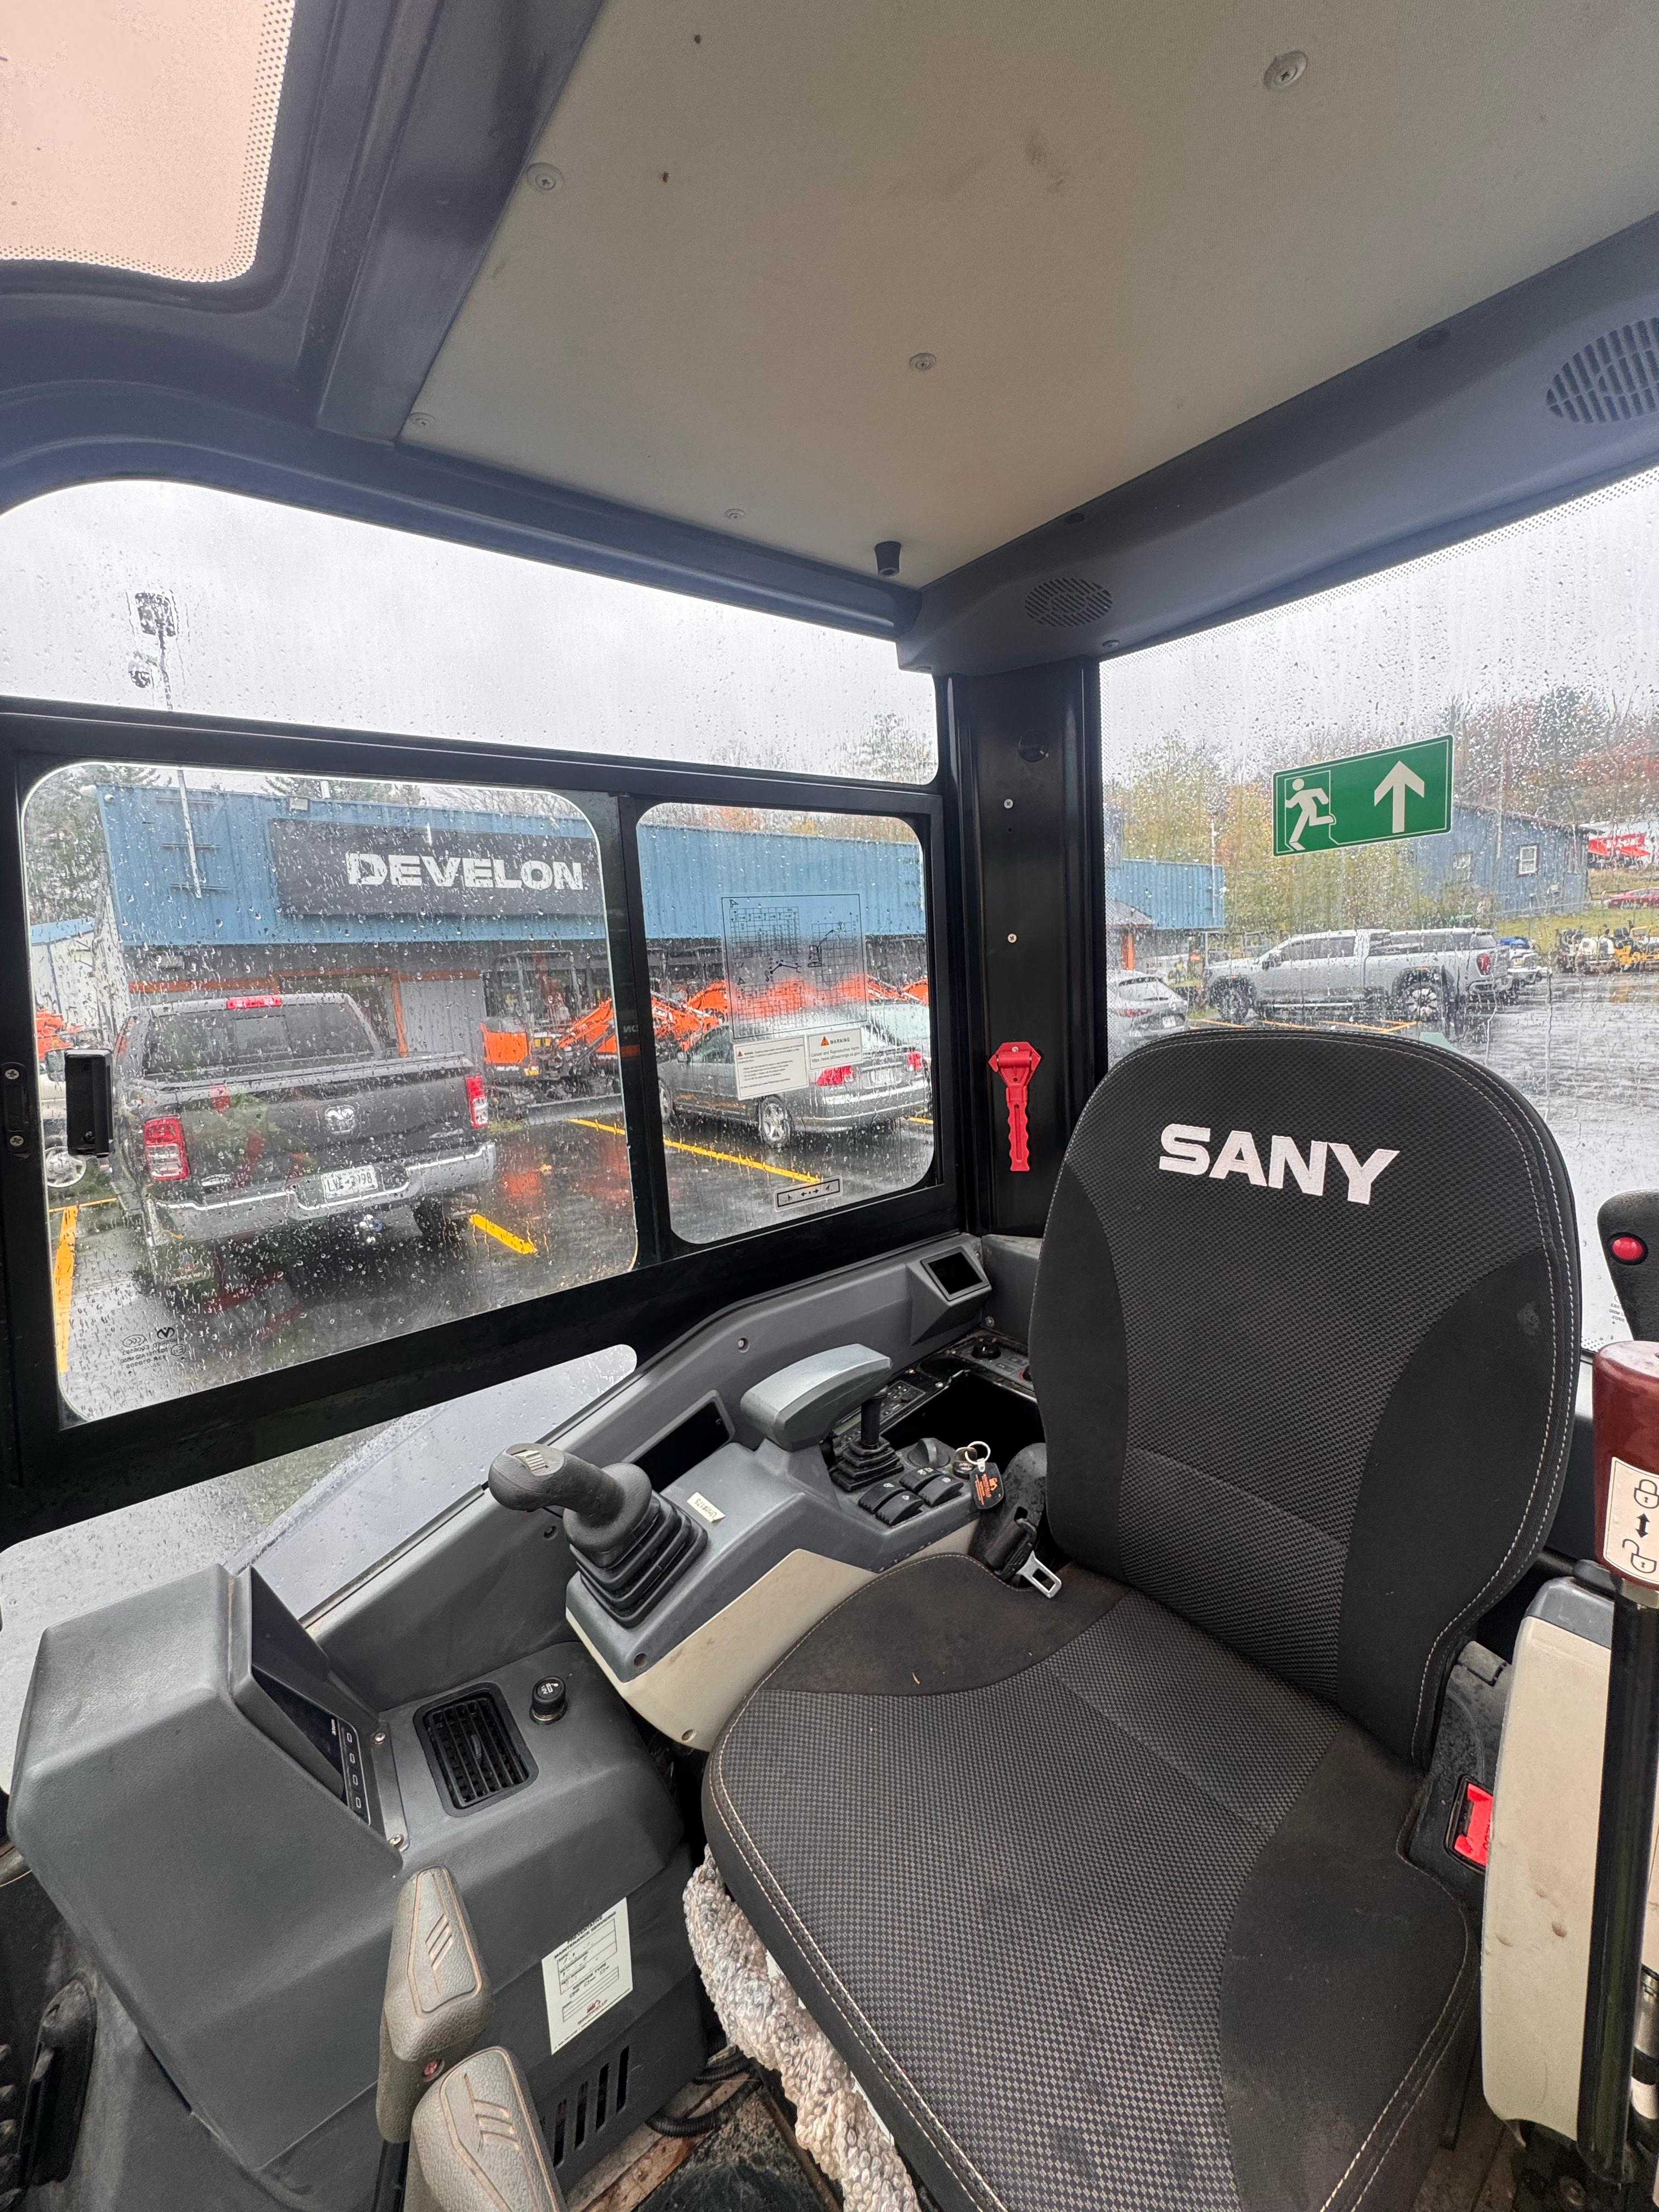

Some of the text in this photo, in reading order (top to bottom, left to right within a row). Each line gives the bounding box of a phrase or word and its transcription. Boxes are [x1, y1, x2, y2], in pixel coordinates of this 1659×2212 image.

[346, 853, 583, 890] DEVELON
[1159, 1123, 1400, 1205] SANY
[554, 1911, 617, 1959] MAINTENANCE SERVICING
[567, 1915, 602, 1944] PREVENTATIVE
